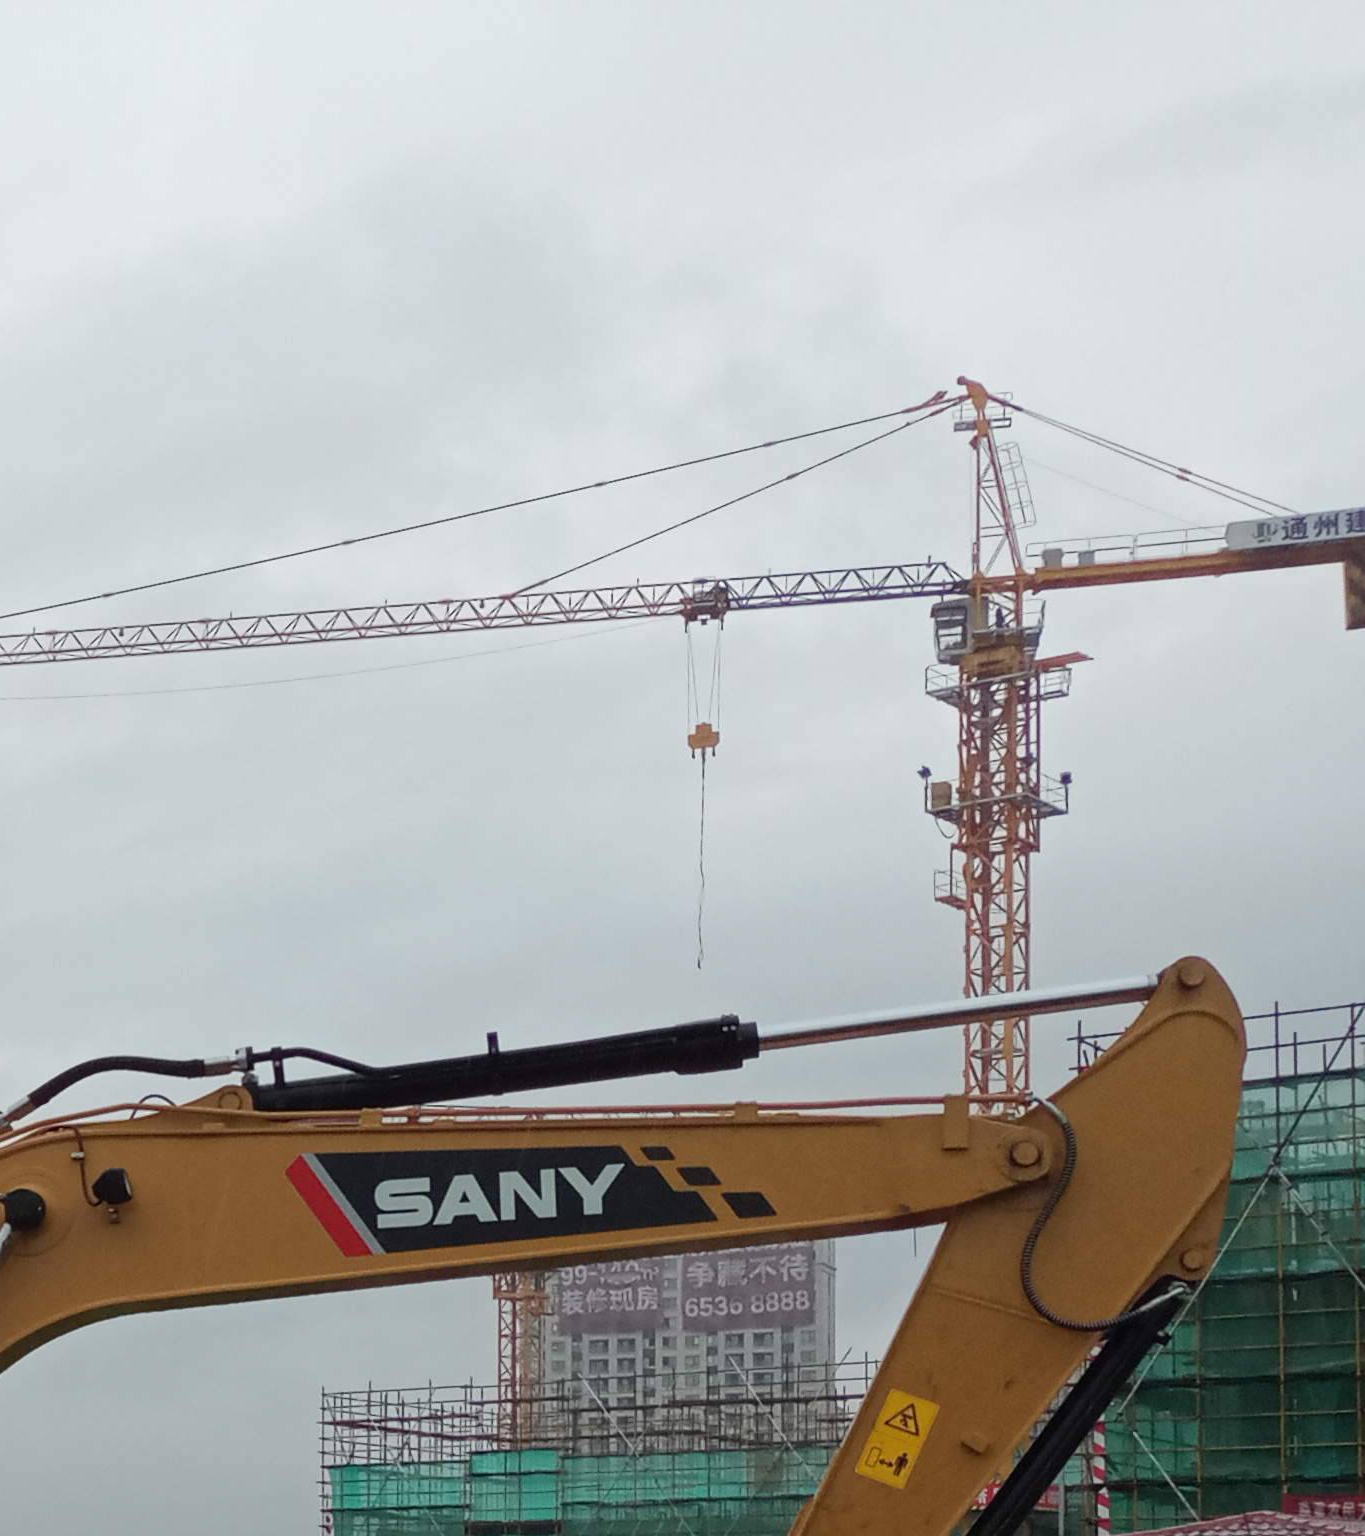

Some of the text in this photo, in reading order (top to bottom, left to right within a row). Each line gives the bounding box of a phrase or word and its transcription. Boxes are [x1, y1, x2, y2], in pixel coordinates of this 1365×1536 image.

[374, 1163, 625, 1229] SANY
[561, 1286, 659, 1316] 装修现房
[750, 1290, 811, 1315] 8888
